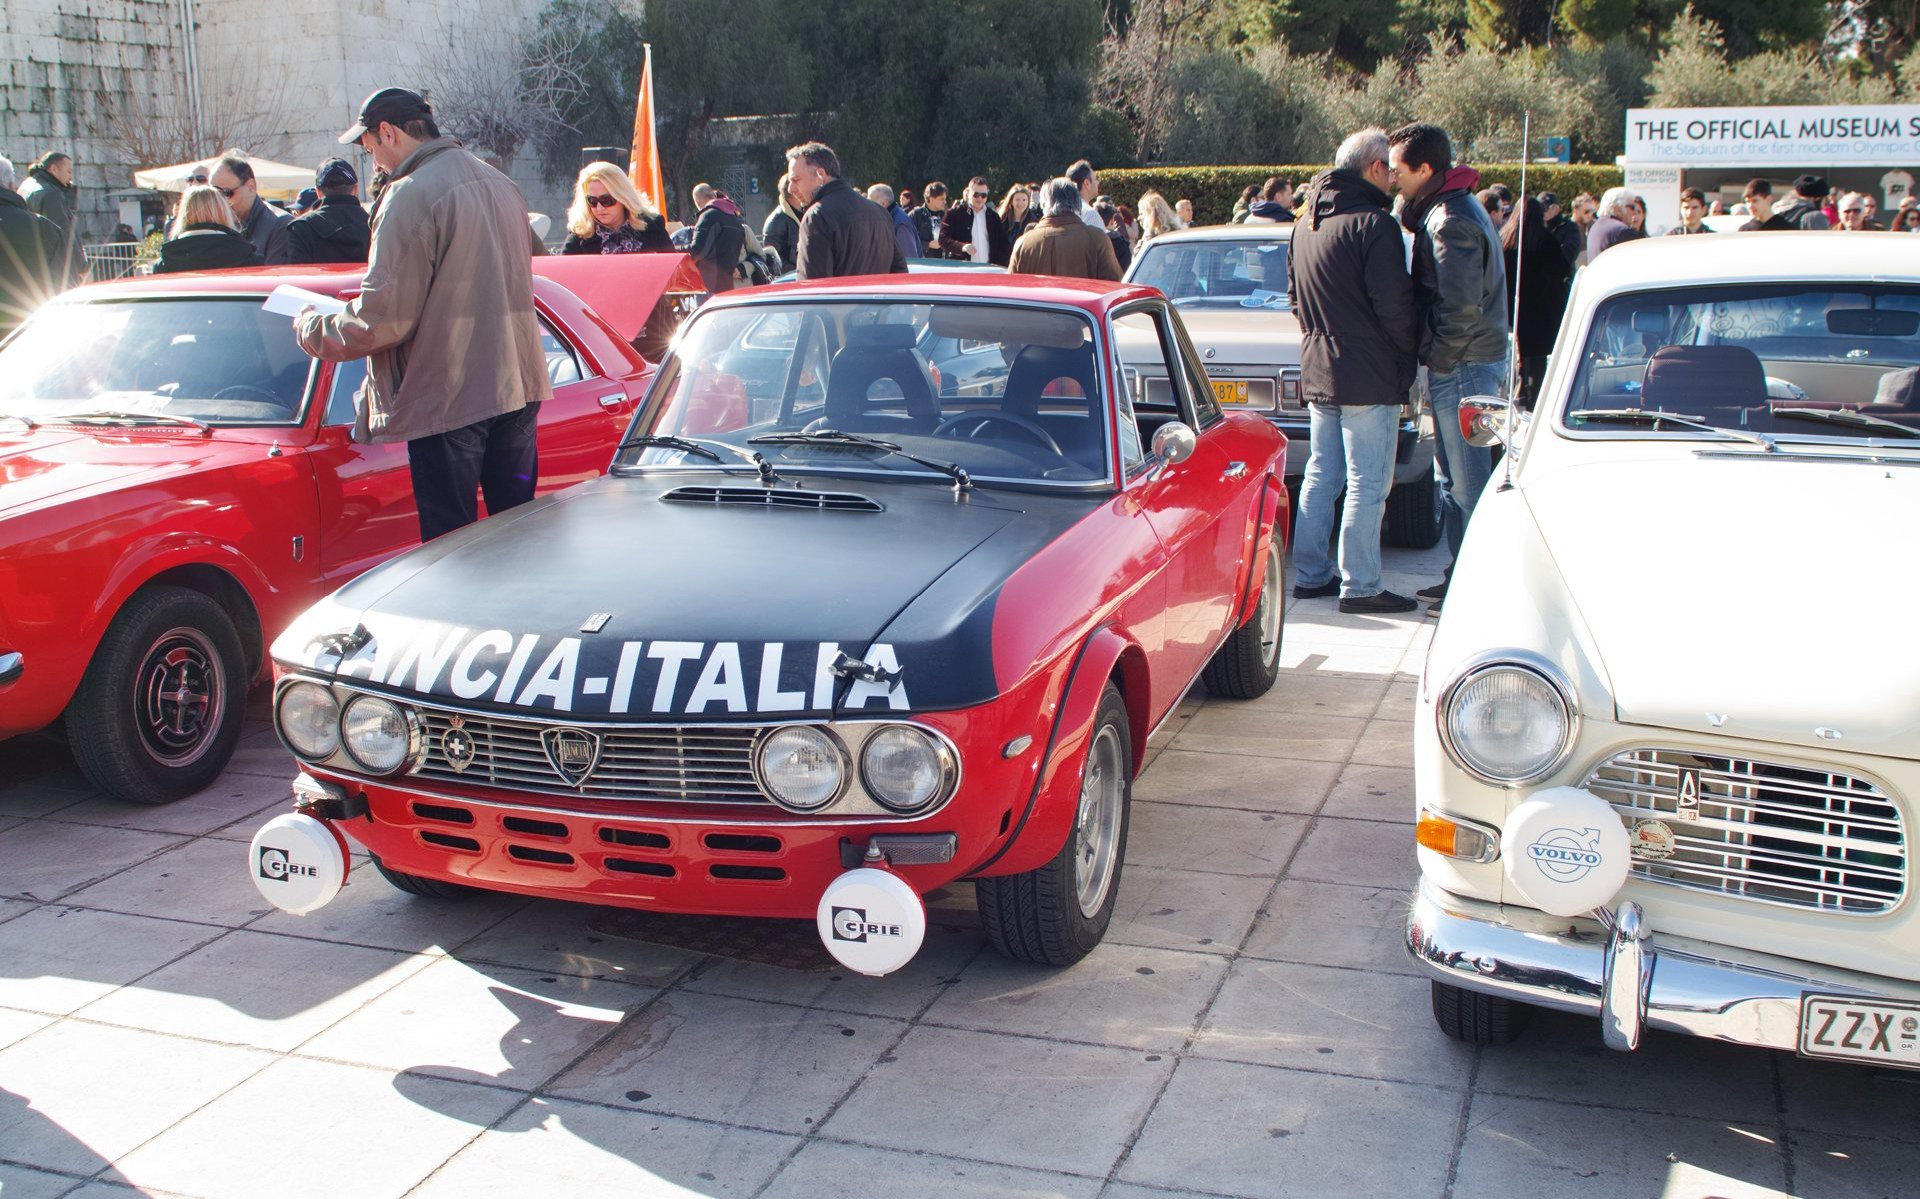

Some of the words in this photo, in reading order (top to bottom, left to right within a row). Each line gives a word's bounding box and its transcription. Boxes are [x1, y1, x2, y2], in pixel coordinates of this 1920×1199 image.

[1635, 121, 1679, 140] THE
[1686, 119, 1791, 140] OFFICIAL
[1798, 118, 1901, 138] MUSEUM
[1651, 143, 1673, 156] The
[1676, 142, 1728, 155] Stadium
[1731, 141, 1745, 154] of
[1747, 141, 1768, 154] the
[1772, 141, 1795, 154] first
[1800, 141, 1850, 154] modern
[1853, 140, 1910, 155] Olympic
[751, 177, 759, 193] 3
[1213, 384, 1233, 400] 87
[1531, 846, 1598, 864] VOLVO
[271, 861, 317, 877] CIBIE
[845, 922, 900, 936] CIBIE
[1814, 1008, 1894, 1053] ZZX
